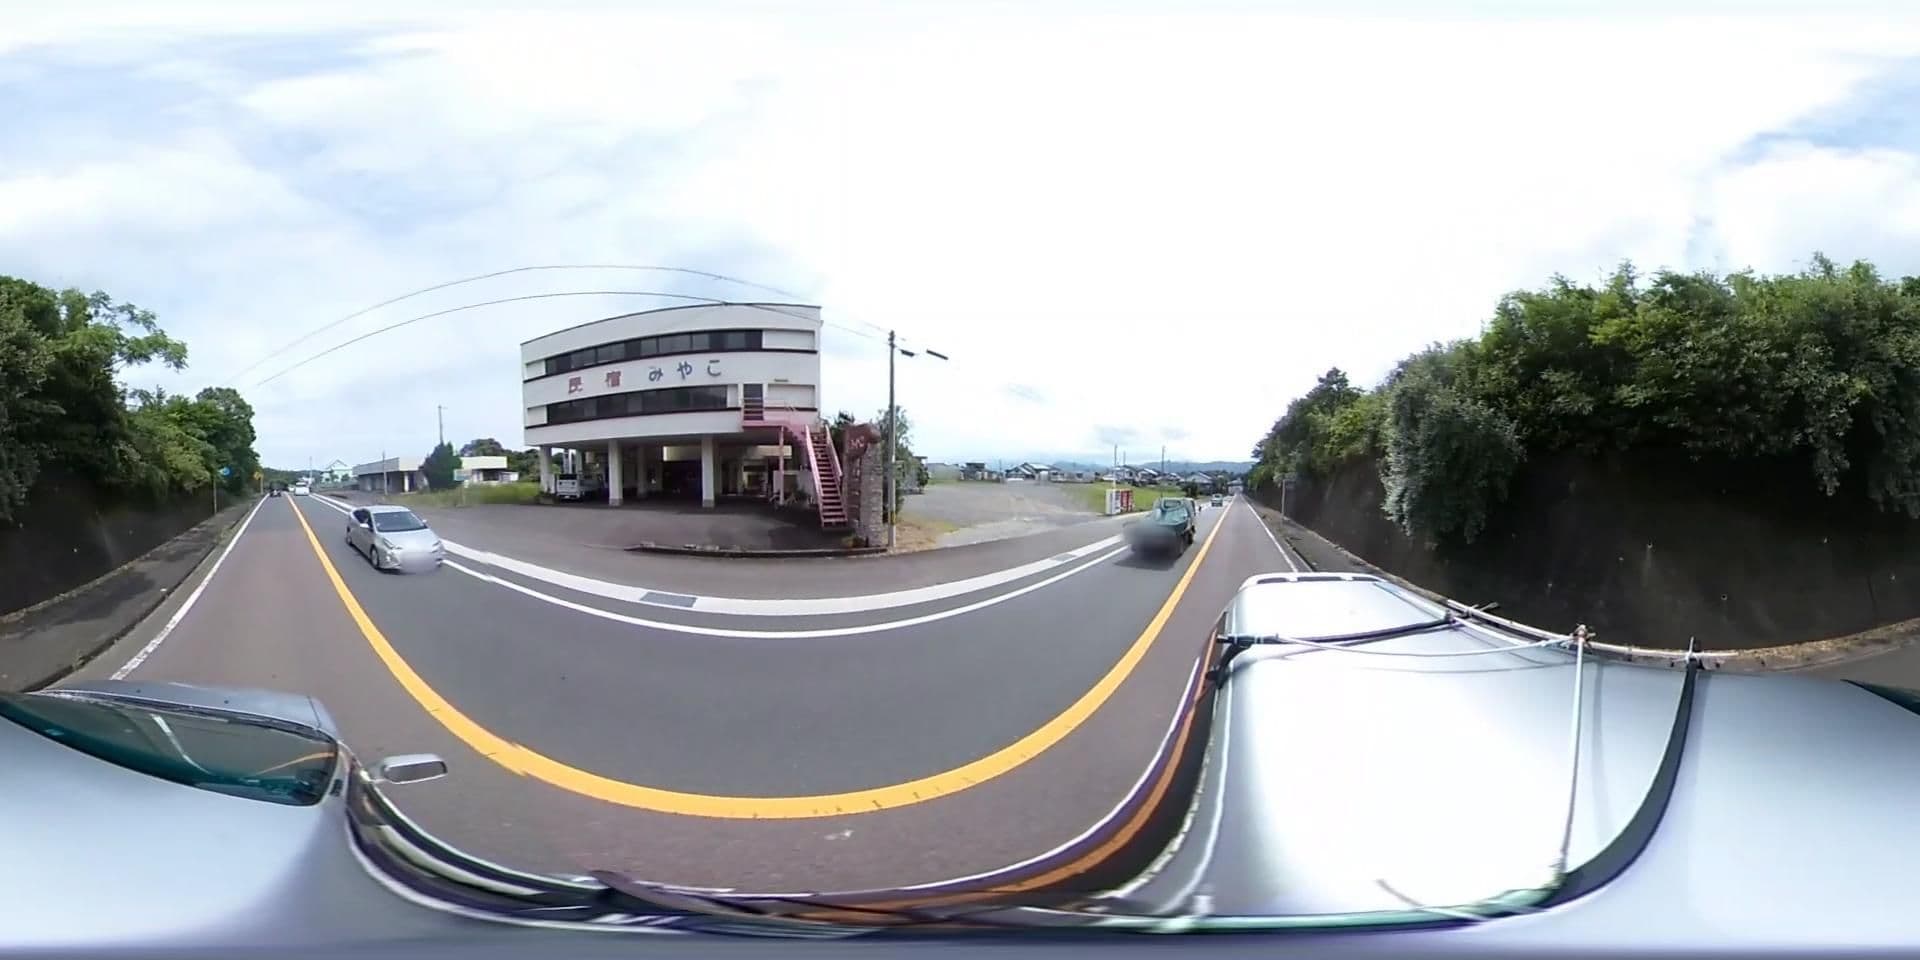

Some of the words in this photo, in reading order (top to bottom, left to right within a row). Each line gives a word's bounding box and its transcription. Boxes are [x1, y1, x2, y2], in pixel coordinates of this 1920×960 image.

[568, 371, 621, 394] 民宿
[649, 360, 721, 382] みやこ
